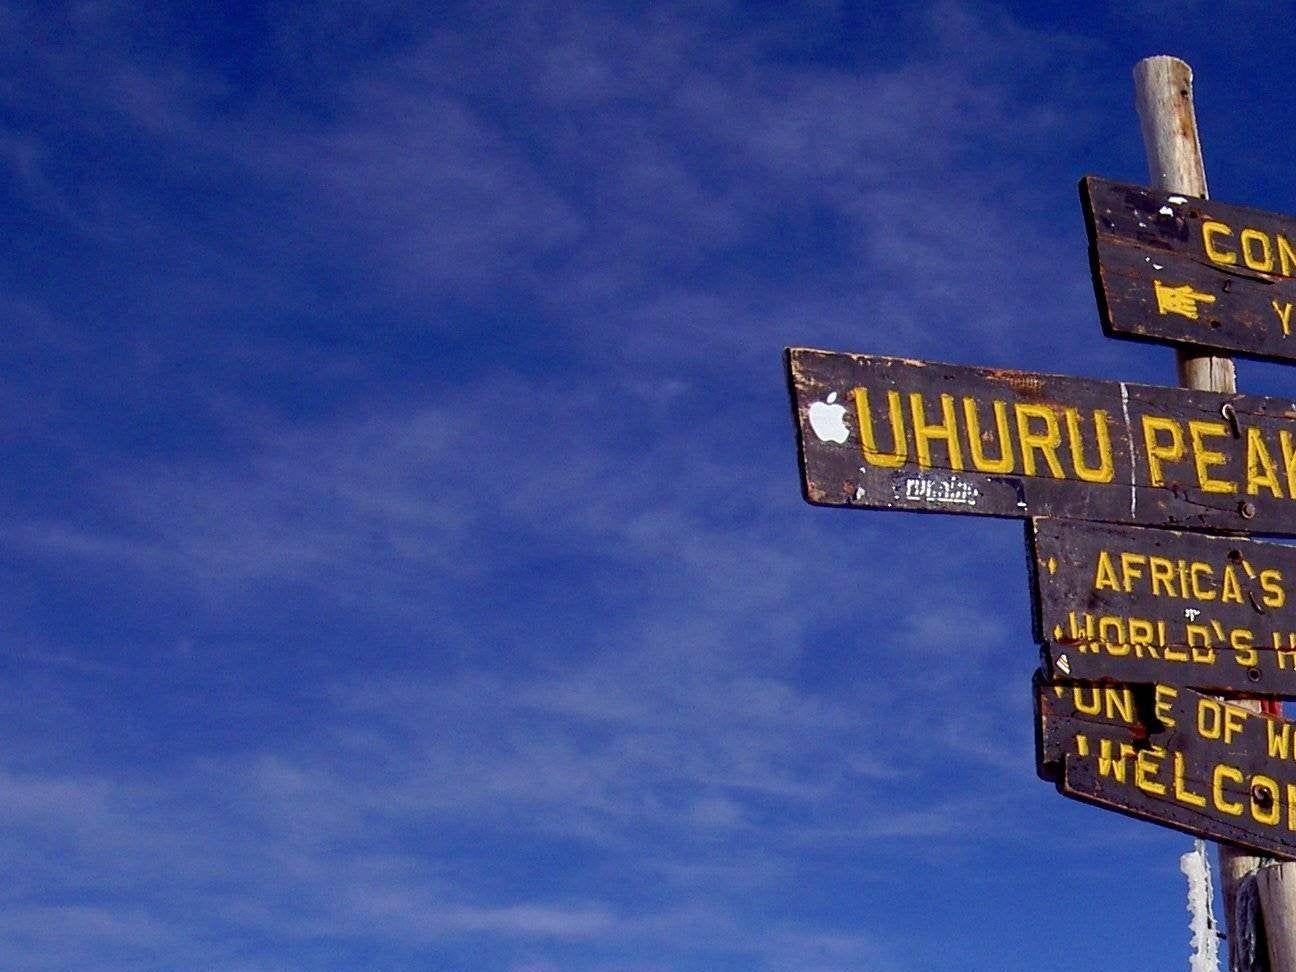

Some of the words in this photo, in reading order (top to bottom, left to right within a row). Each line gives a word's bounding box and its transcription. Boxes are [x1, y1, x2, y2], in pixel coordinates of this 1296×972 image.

[854, 386, 1115, 483] UHURU
[1094, 551, 1286, 608] AFRICA'S
[1067, 612, 1259, 667] WORLD'S
[1197, 698, 1248, 744] OF
